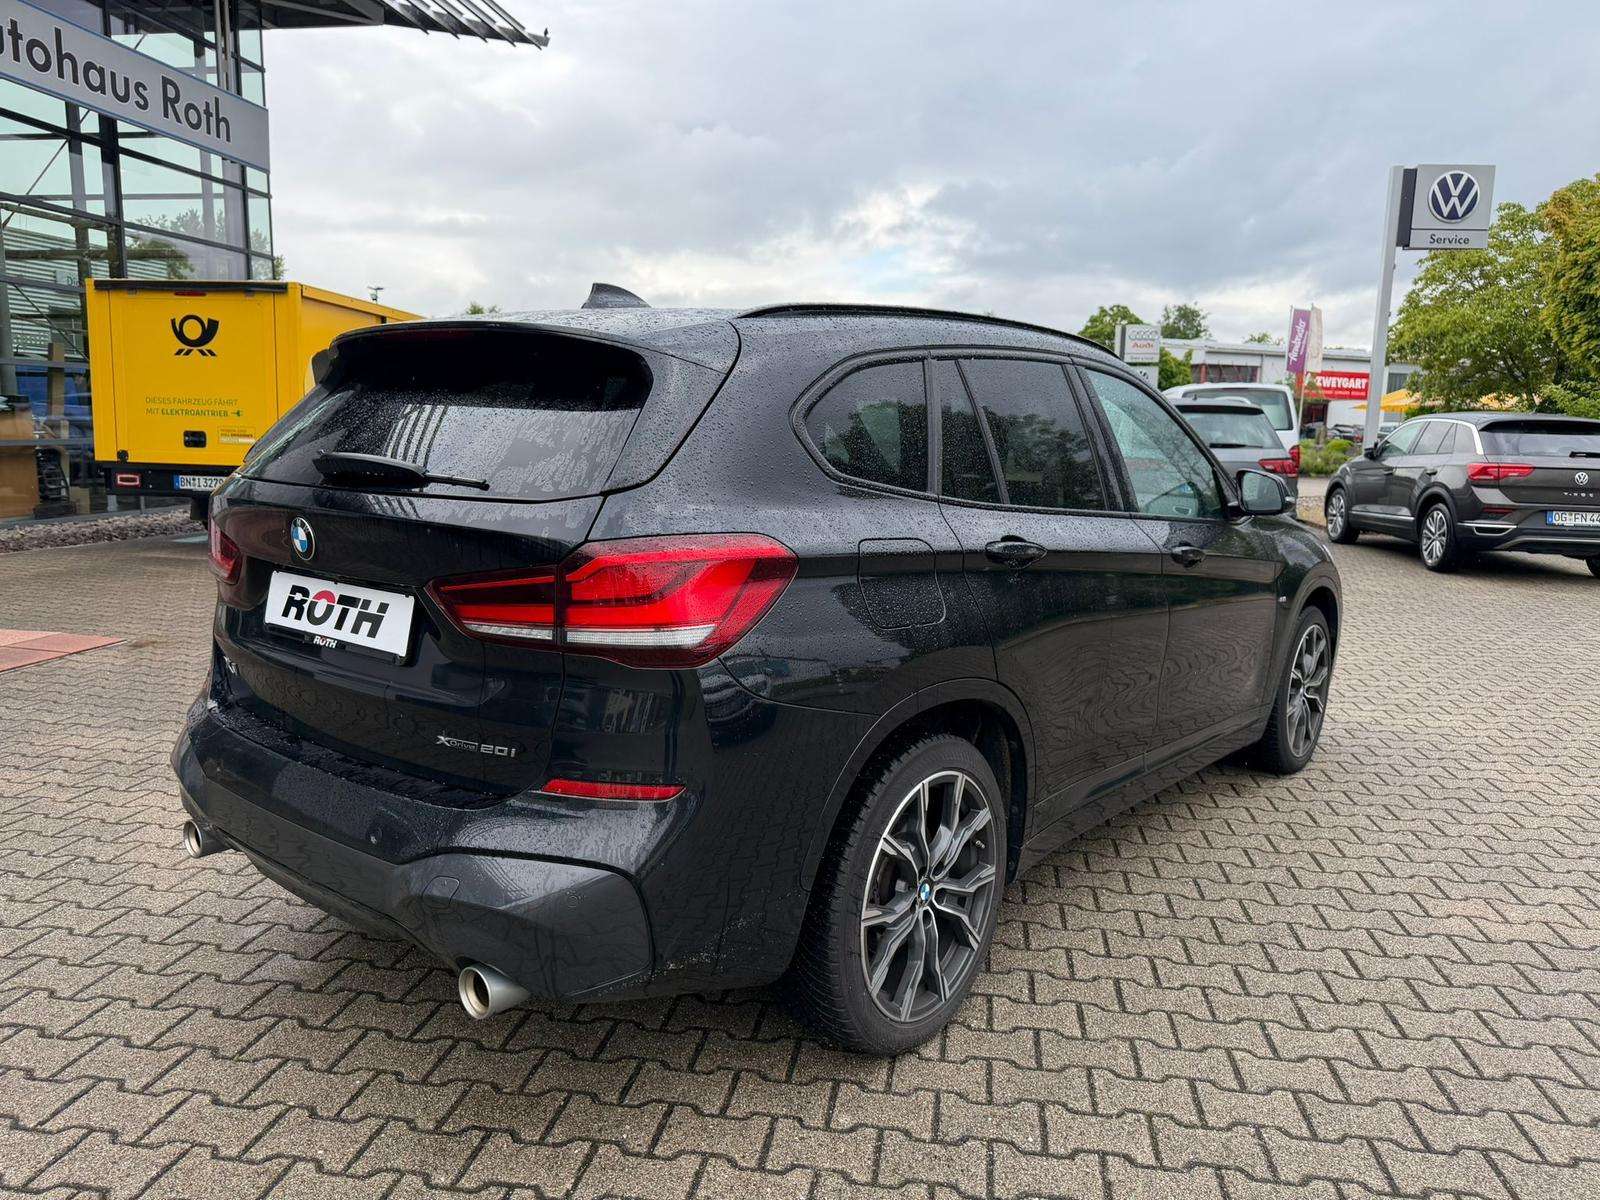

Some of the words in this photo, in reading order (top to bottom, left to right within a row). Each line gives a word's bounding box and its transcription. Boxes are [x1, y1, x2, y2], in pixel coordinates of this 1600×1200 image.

[0, 18, 150, 111] tohaus
[161, 75, 232, 143] Roth
[1429, 233, 1470, 245] Service
[1131, 341, 1154, 349] Audi
[145, 396, 171, 404] DIESES
[173, 397, 213, 406] FAHRZEUG
[161, 408, 229, 417] ELEKTROANTRIEB
[1554, 512, 1568, 522] OG
[1573, 512, 1588, 523] FN
[281, 584, 390, 639] ROTH
[313, 635, 338, 648] ROTH
